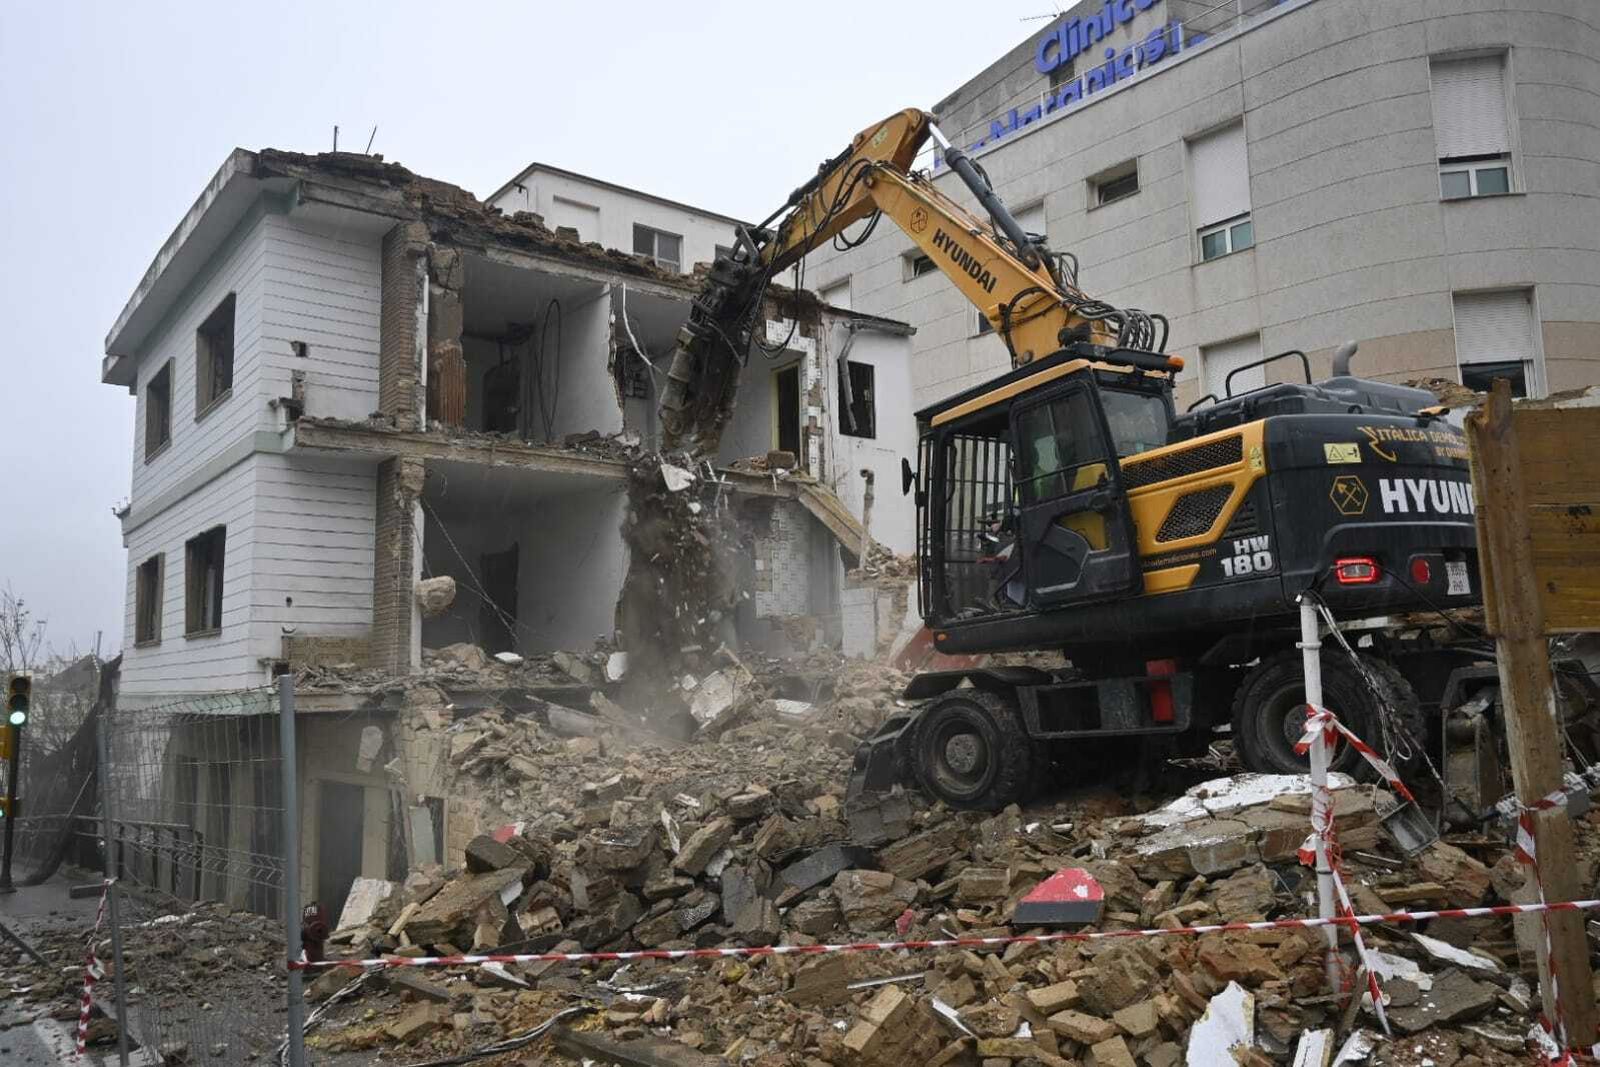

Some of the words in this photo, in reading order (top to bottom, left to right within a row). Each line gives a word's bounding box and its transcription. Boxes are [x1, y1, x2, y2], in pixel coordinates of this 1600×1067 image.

[932, 227, 998, 294] HYUNDAI
[1233, 535, 1269, 556] HW
[1220, 551, 1273, 577] 180
